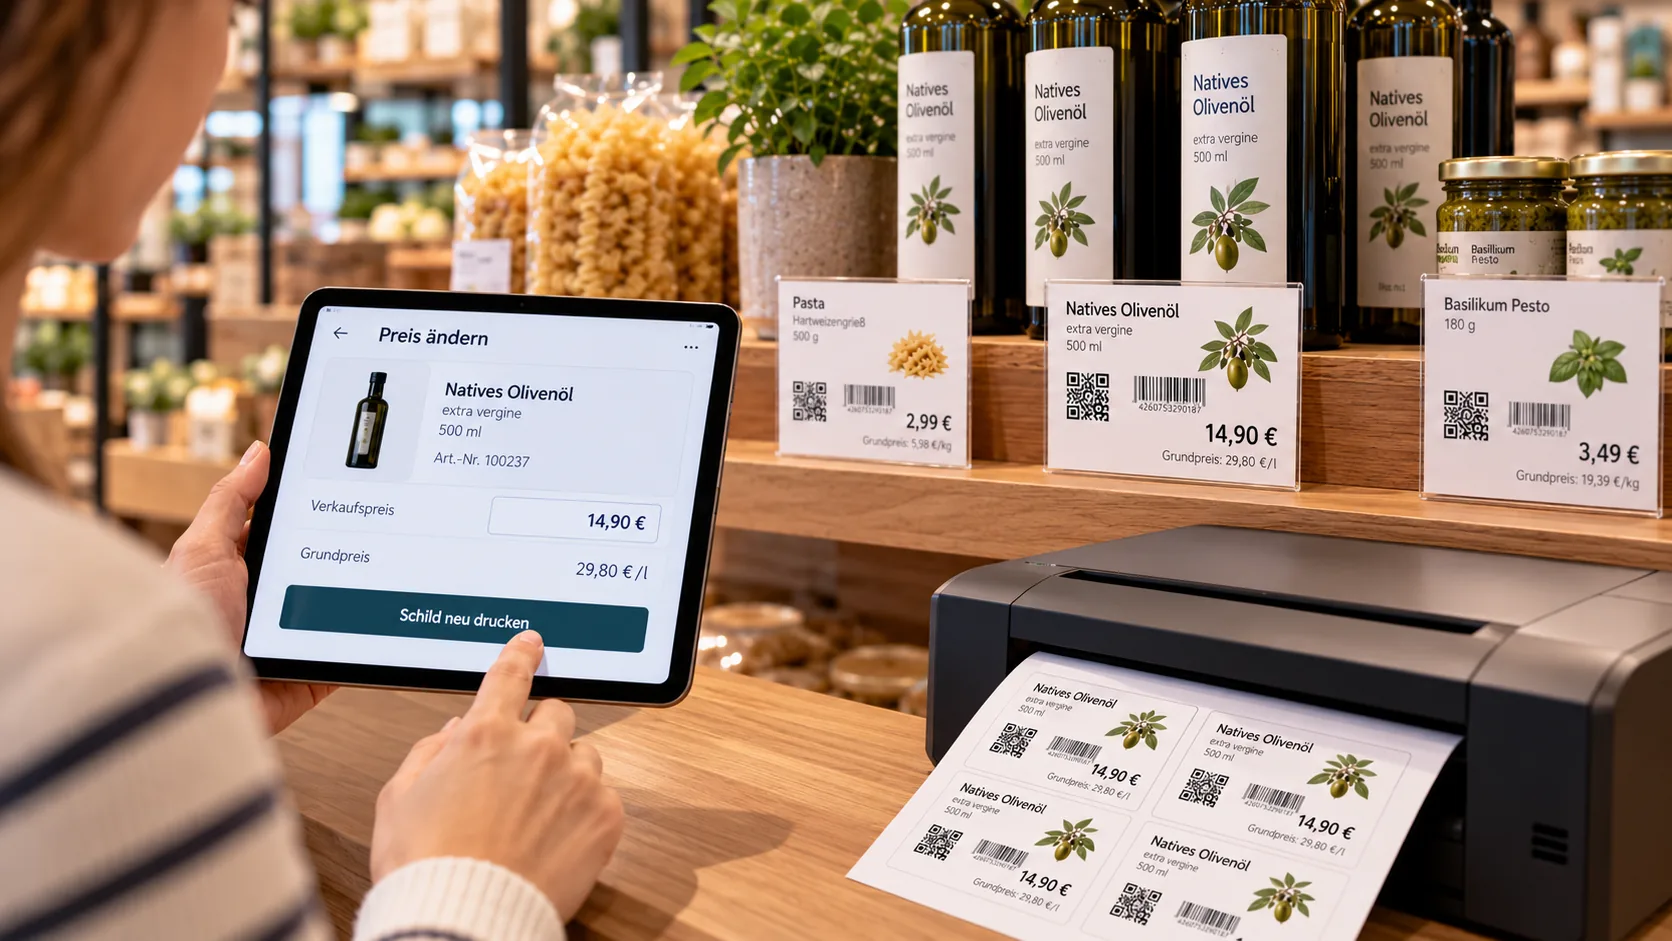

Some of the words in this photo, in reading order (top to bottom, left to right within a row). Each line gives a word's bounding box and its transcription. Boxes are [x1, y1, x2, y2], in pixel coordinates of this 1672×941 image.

[906, 82, 949, 97] Natives
[1035, 82, 1081, 99] Natives
[1194, 73, 1249, 91] Natives
[1193, 95, 1255, 116] Olivenöl
[1370, 90, 1423, 106] Natives
[906, 101, 954, 118] Olivenöl
[1034, 102, 1087, 122] Olivenöl
[1369, 110, 1428, 128] Olivenöl
[1035, 139, 1053, 149] extra
[1055, 138, 1090, 151] vergine
[1193, 134, 1216, 145] extra
[1218, 132, 1258, 146] vergine
[1035, 154, 1050, 166] 500
[1053, 154, 1065, 166] ml
[1194, 151, 1212, 163] 500
[1214, 150, 1228, 162] ml
[793, 296, 825, 310] Pasta
[1066, 300, 1117, 317] Natives
[1121, 302, 1180, 318] Olivenöl
[1444, 297, 1507, 312] Basilikum
[1512, 298, 1550, 313] Pesto
[1066, 324, 1092, 334] extra
[1095, 324, 1133, 338] vergine
[1444, 318, 1465, 330] 180
[1468, 321, 1476, 334] g
[379, 327, 421, 343] Preis
[426, 329, 489, 346] ändern
[793, 330, 810, 341] 500
[812, 333, 819, 344] g
[1066, 340, 1086, 352] 500
[1089, 341, 1102, 352] ml
[445, 382, 503, 398] Natives
[507, 385, 574, 402] Olivenöl
[442, 406, 473, 417] extra
[477, 408, 522, 421] vergine
[1138, 403, 1202, 414] 4260753290187
[438, 424, 463, 437] 500
[466, 426, 482, 438] ml
[906, 413, 938, 432] 2,99
[942, 415, 952, 431] €
[862, 435, 909, 449] Grundpreis:
[911, 438, 929, 450] 5,98
[931, 440, 952, 453] €/kg
[1205, 423, 1259, 447] 14,90
[1264, 427, 1278, 446] €
[433, 452, 480, 466] Art.-Nr.
[485, 455, 530, 468] 100237
[1162, 449, 1222, 465] Grundpreis:
[1225, 455, 1256, 468] 29,80
[1260, 457, 1277, 470] €/l
[1579, 442, 1621, 465] 3,49
[1627, 445, 1640, 465] €
[1516, 469, 1579, 485] Grundpreis:
[1581, 474, 1610, 488] 19,39
[1613, 476, 1640, 492] €/kg
[311, 499, 395, 517] Verkaufspreis
[588, 513, 631, 531] 14,90
[635, 516, 646, 530] €
[300, 547, 370, 564] Grundpreis
[576, 562, 618, 580] 29,80
[400, 608, 442, 624] Schild
[445, 614, 470, 626] neu
[474, 613, 529, 630] drucken
[1033, 682, 1072, 699] Natives
[1073, 691, 1118, 709] Olivenöl
[1018, 704, 1035, 715] 500
[1033, 708, 1046, 717] ml
[1216, 723, 1260, 742] Natives
[1263, 733, 1314, 754] Olivenöl
[1203, 747, 1222, 759] 500
[1222, 753, 1235, 762] ml
[1233, 743, 1265, 756] vergine
[1091, 763, 1128, 783] 14,90
[1129, 774, 1142, 786] €
[1047, 772, 1091, 790] Grundpreis:
[1091, 784, 1116, 797] 29,80
[1116, 790, 1131, 800] €/l
[960, 782, 1000, 801] Natives
[1001, 794, 1048, 814] Olivenöl
[944, 805, 961, 816] 500
[960, 811, 973, 819] ml
[1298, 814, 1340, 836] 14,90
[1342, 826, 1356, 840] €
[1247, 823, 1299, 844] Grundpreis:
[1300, 837, 1328, 851] 29,80
[1329, 845, 1346, 856] €/l
[1143, 851, 1165, 863] extra
[1167, 857, 1199, 873] vergine
[1150, 835, 1197, 857] Natives
[1198, 848, 1252, 871] Olivenöl
[1136, 861, 1155, 873] 500
[1155, 868, 1170, 878] ml
[1019, 870, 1058, 892] 14,90
[1059, 883, 1072, 897] €
[973, 877, 1019, 899] Grundpreis:
[1019, 892, 1044, 906] 29,80
[1045, 900, 1060, 912] €/l
